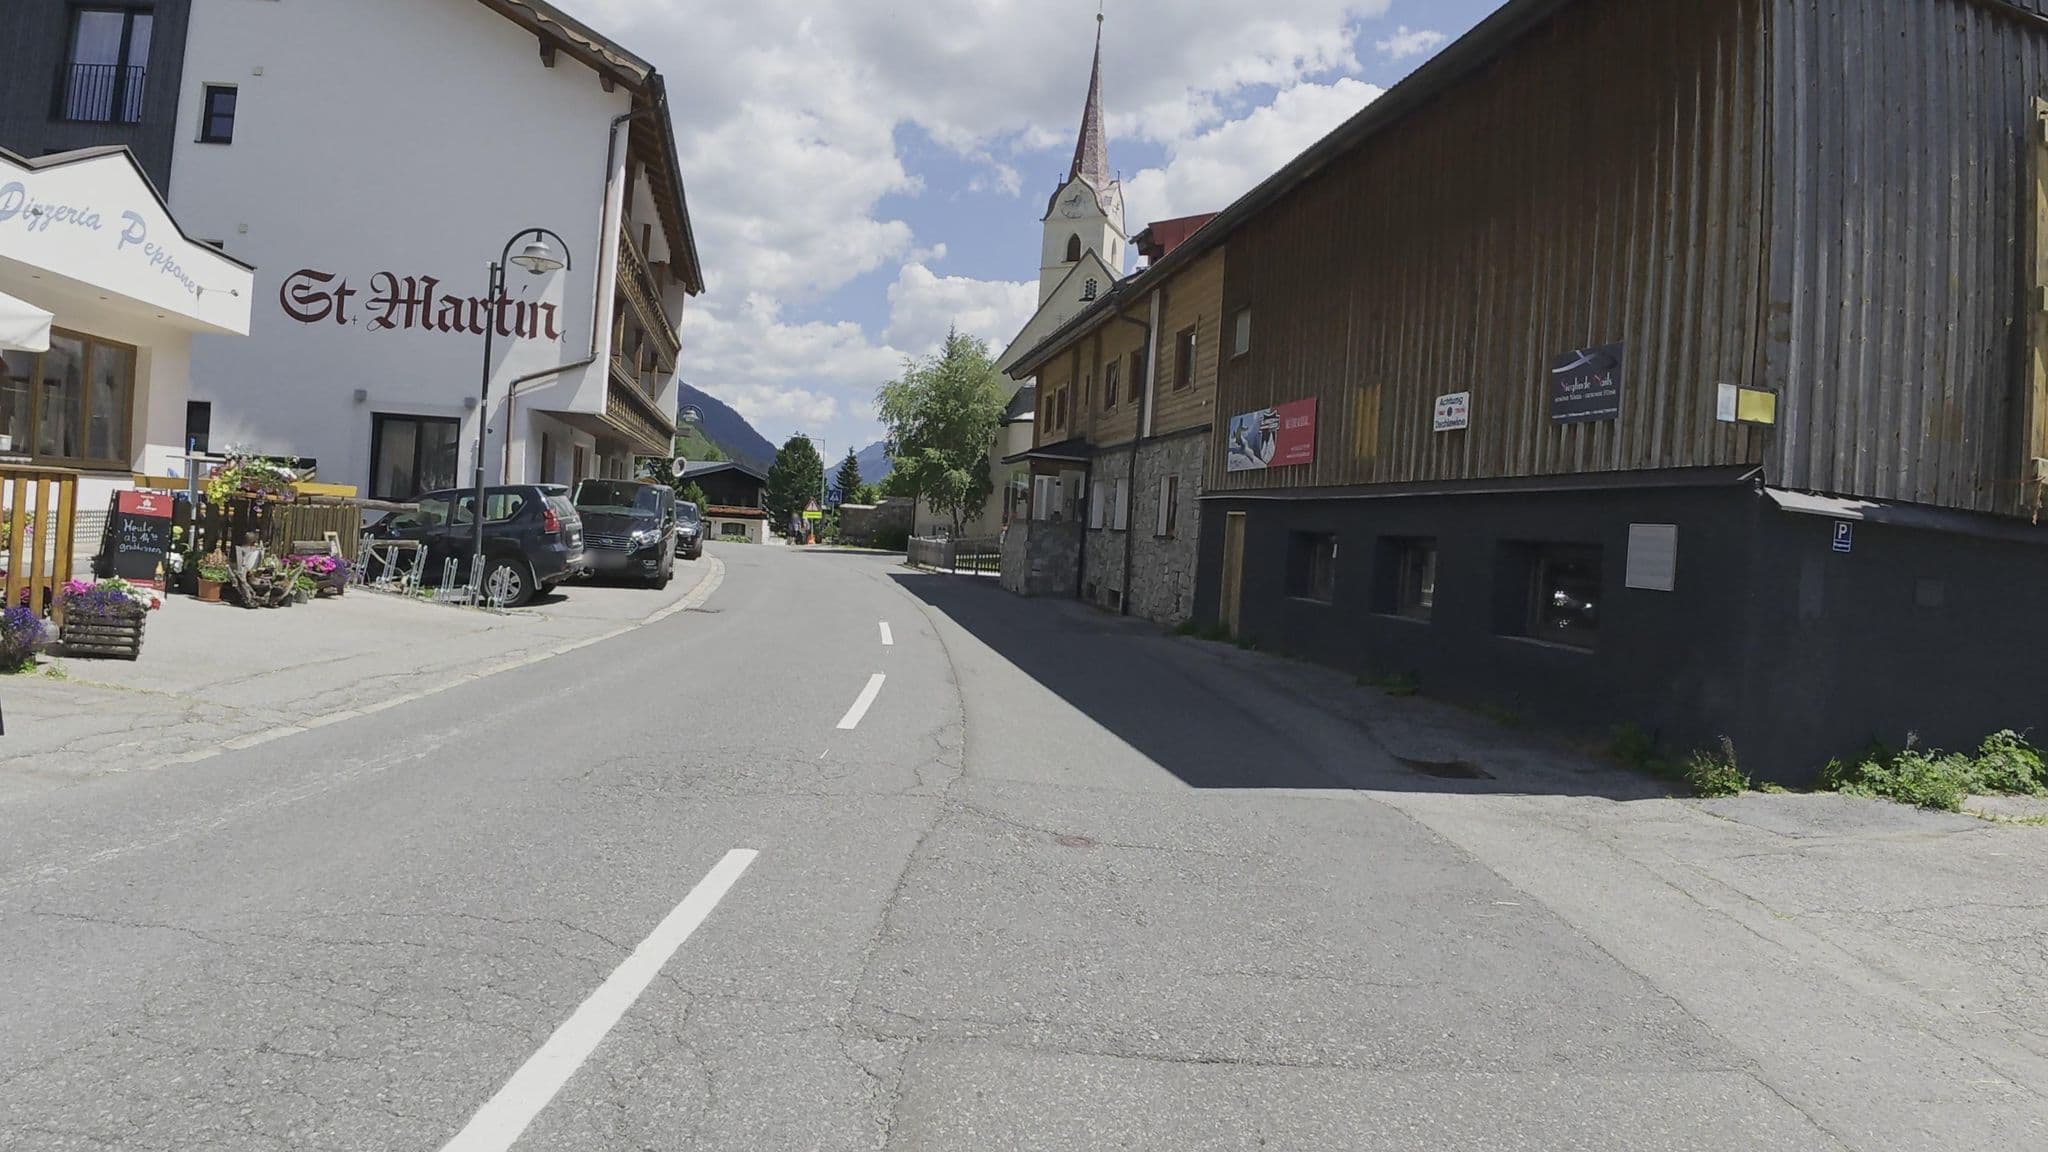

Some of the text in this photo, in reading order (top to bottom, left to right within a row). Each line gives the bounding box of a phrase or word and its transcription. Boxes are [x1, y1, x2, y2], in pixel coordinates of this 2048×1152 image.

[0, 181, 102, 232] Pizzeria
[365, 271, 563, 341] Martin
[1838, 524, 1848, 539] P
